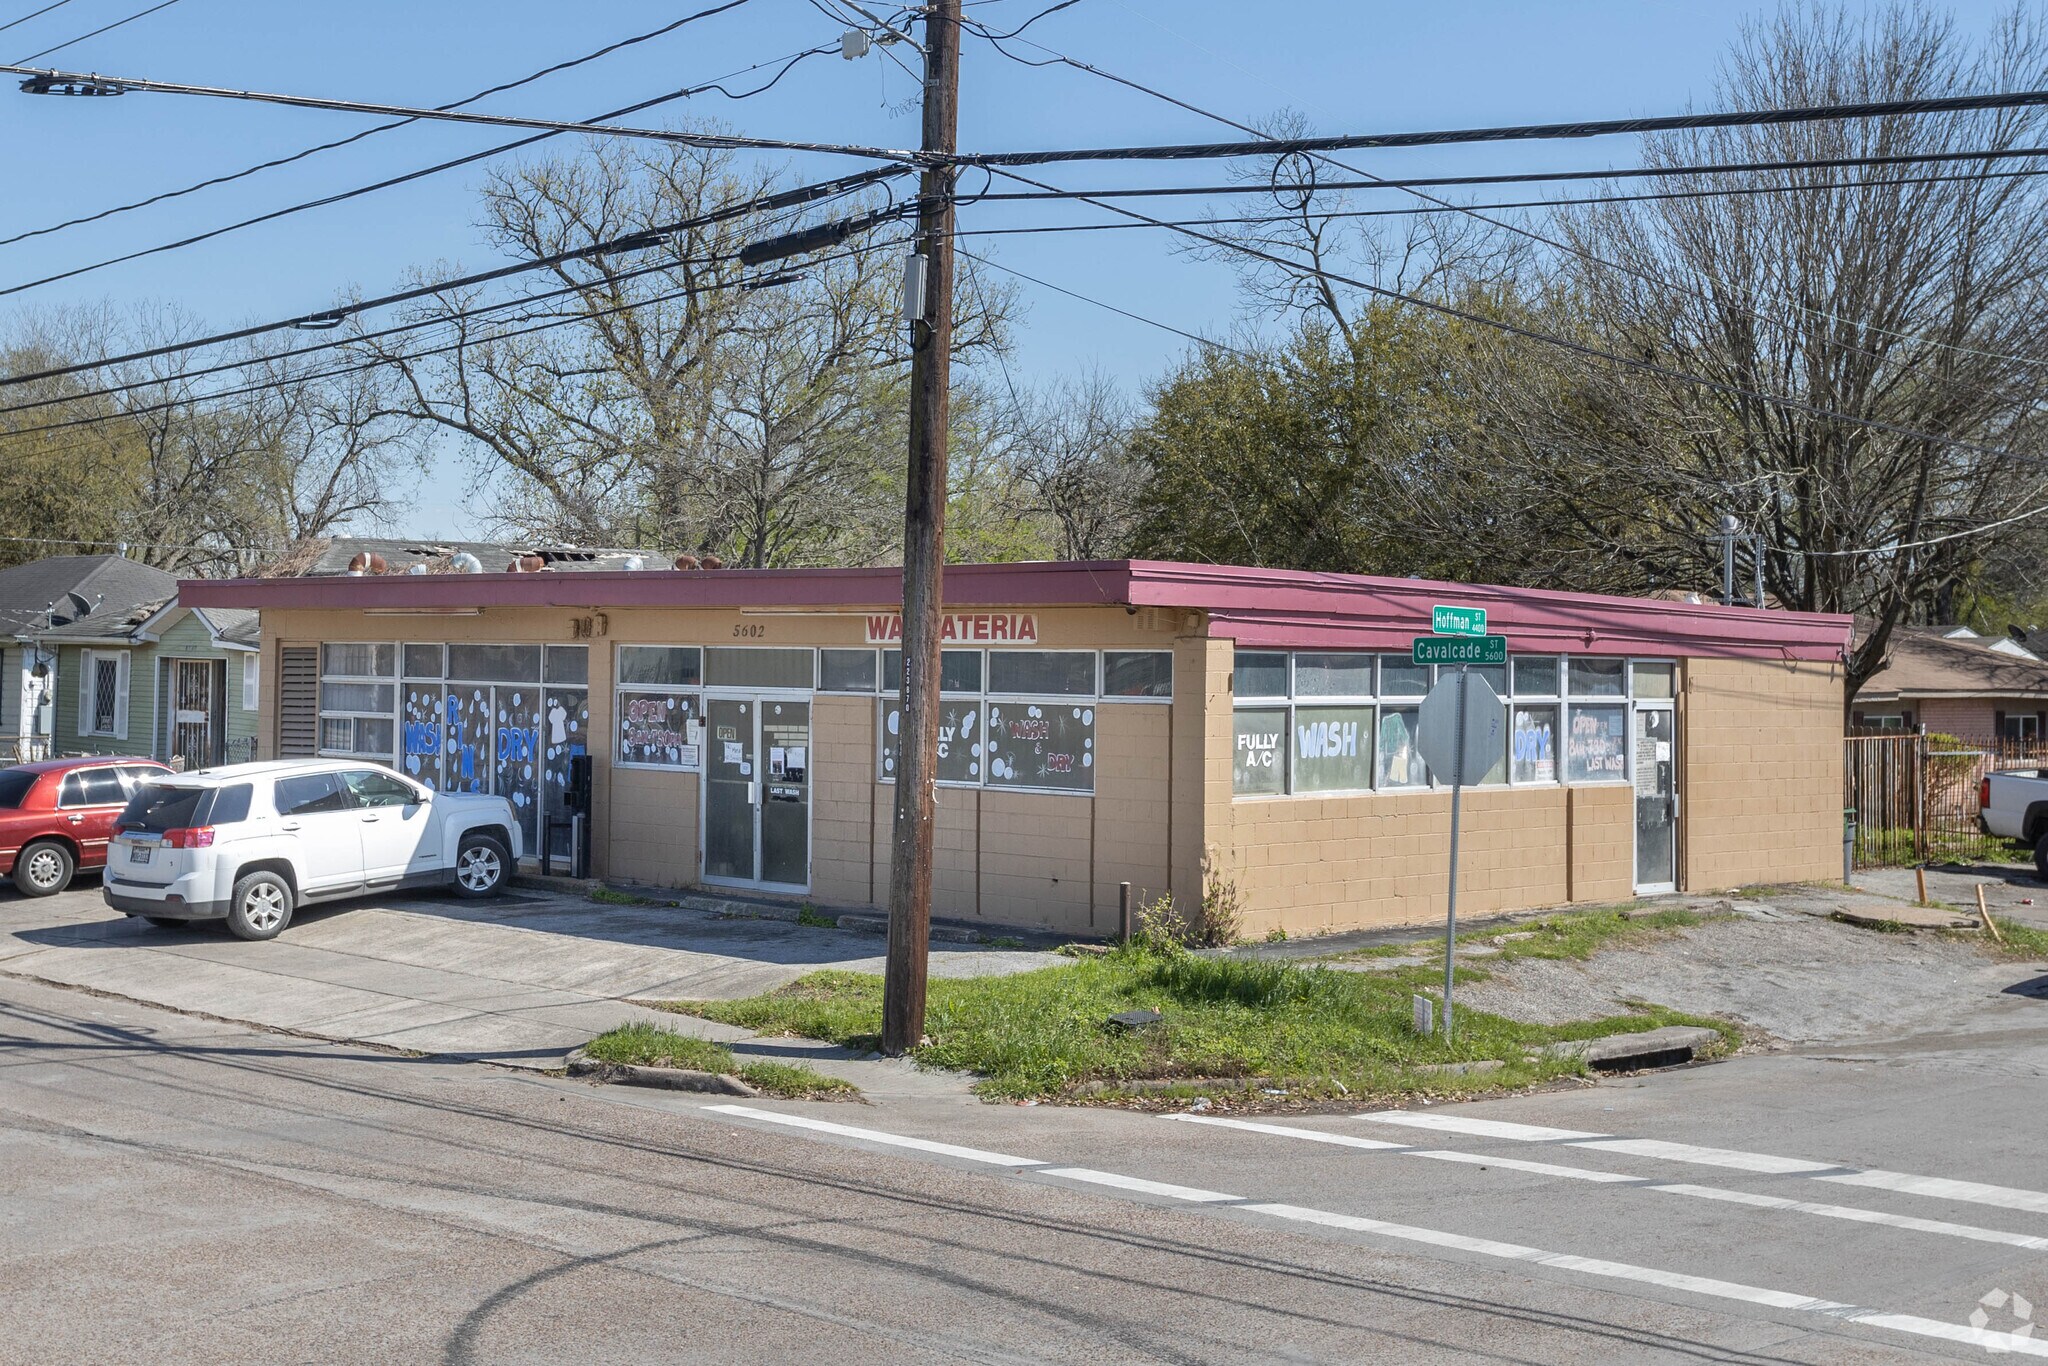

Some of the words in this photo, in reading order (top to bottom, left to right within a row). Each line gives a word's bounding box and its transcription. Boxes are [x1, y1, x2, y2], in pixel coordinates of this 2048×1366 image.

[867, 614, 1037, 641] WAATERIA
[1435, 611, 1470, 630] Hoffman
[1474, 612, 1482, 621] ST
[1471, 624, 1485, 633] 4400
[733, 624, 765, 638] 5602
[1417, 642, 1481, 659] Cavalcade
[1489, 639, 1499, 649] ST
[1484, 651, 1504, 661] 5600
[628, 699, 667, 723] OPEN
[718, 727, 736, 739] OPEN
[1009, 719, 1049, 740] WASH
[1573, 715, 1597, 735] OPEN
[498, 727, 540, 763] DRY
[1034, 742, 1042, 755] &
[1237, 733, 1279, 750] FULLY
[1297, 721, 1358, 759] WASH
[1515, 724, 1550, 762] DRY
[1047, 752, 1075, 773] DRY
[1245, 751, 1273, 768] A/C
[1587, 756, 1603, 771] LAST
[784, 788, 800, 796] WASH
